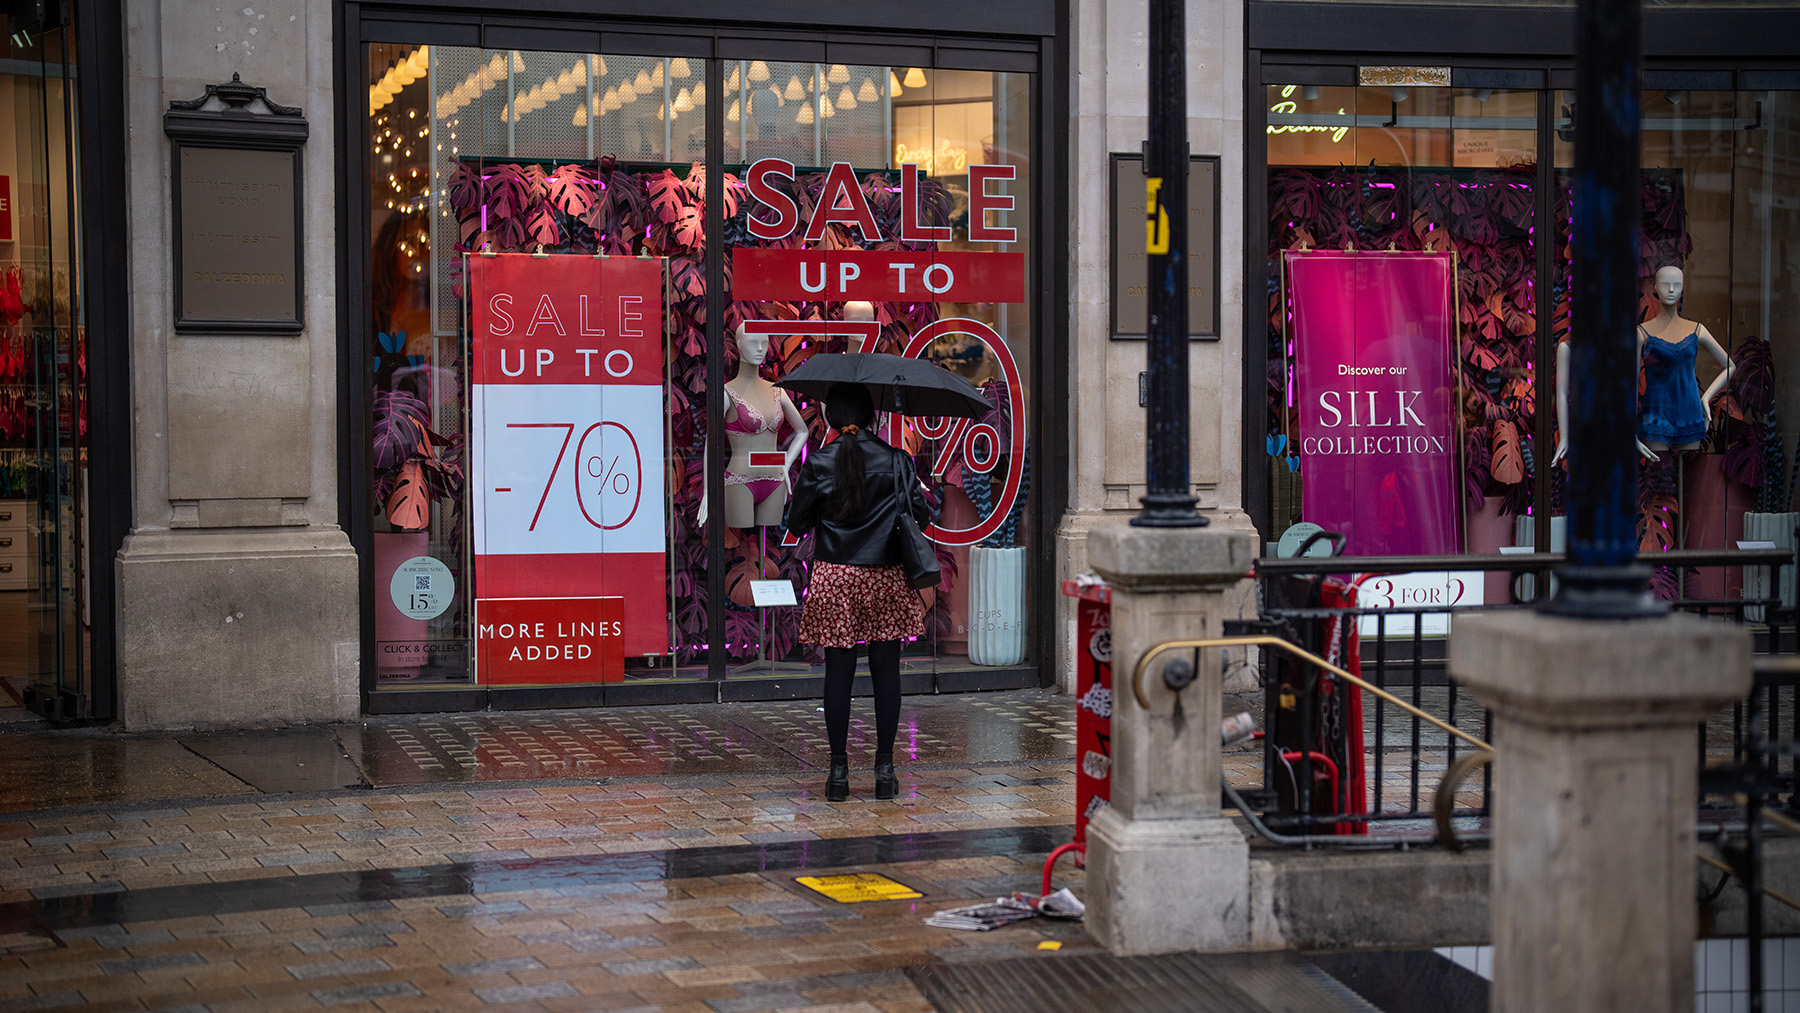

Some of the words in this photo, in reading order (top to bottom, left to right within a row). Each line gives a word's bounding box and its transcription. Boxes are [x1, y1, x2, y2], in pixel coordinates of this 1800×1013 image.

[218, 197, 259, 206] UOMO
[746, 157, 1017, 243] SALE
[191, 232, 286, 245] intimissimi
[192, 271, 286, 285] CALZEDONIA
[800, 262, 861, 293] UP
[889, 263, 954, 294] TO
[490, 293, 643, 337] SALE
[501, 349, 555, 377] UP
[576, 349, 634, 378] TO
[1338, 364, 1386, 375] Discover
[1389, 366, 1407, 375] our
[1319, 391, 1426, 428] SILK
[1303, 436, 1445, 455] COLLECTION
[1374, 579, 1395, 609] 3
[1402, 588, 1441, 604] FOR
[977, 610, 1002, 620] CUPS
[479, 623, 545, 639] MORE
[558, 621, 621, 638] LINES
[384, 645, 411, 653] CLICK
[422, 644, 464, 653] COLLECT
[508, 644, 592, 661] ADDED
[432, 654, 448, 662] FREE
